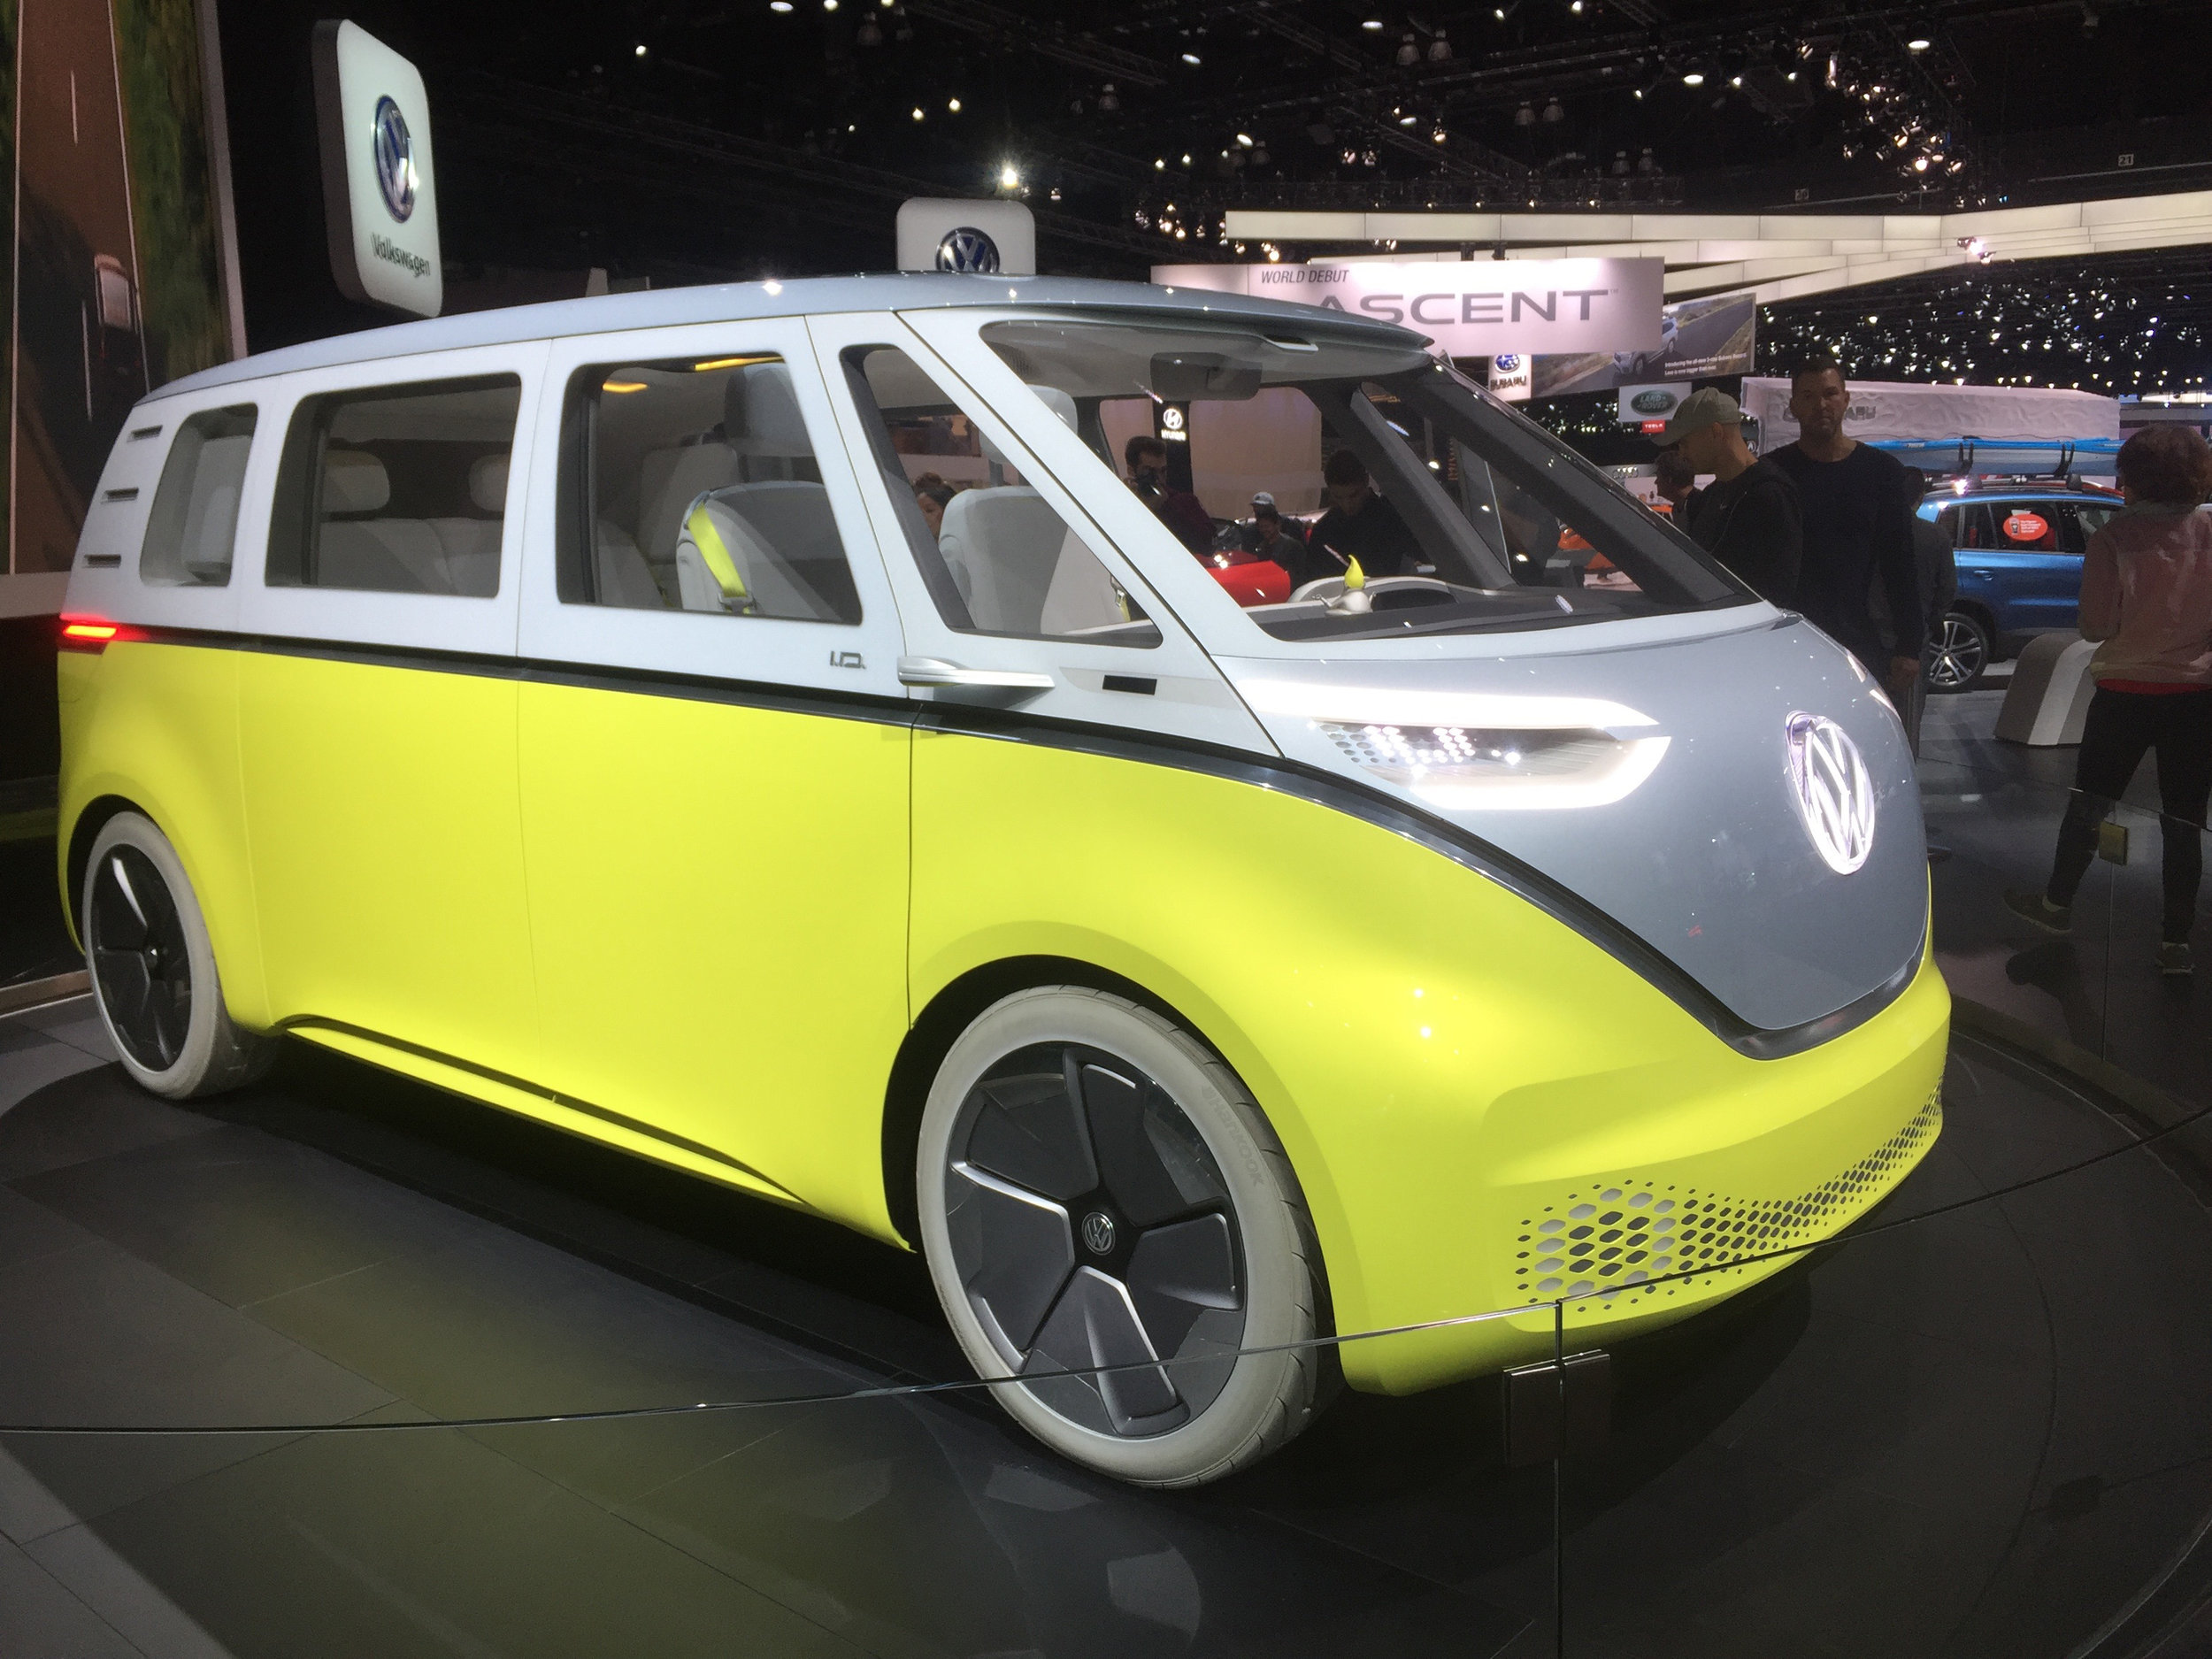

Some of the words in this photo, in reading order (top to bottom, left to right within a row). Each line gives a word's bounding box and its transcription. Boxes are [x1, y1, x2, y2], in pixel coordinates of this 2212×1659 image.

[371, 233, 431, 278] Volkswagen
[1261, 270, 1305, 283] WORLD
[1309, 269, 1349, 283] DEBUT
[1490, 375, 1527, 391] SUBARU
